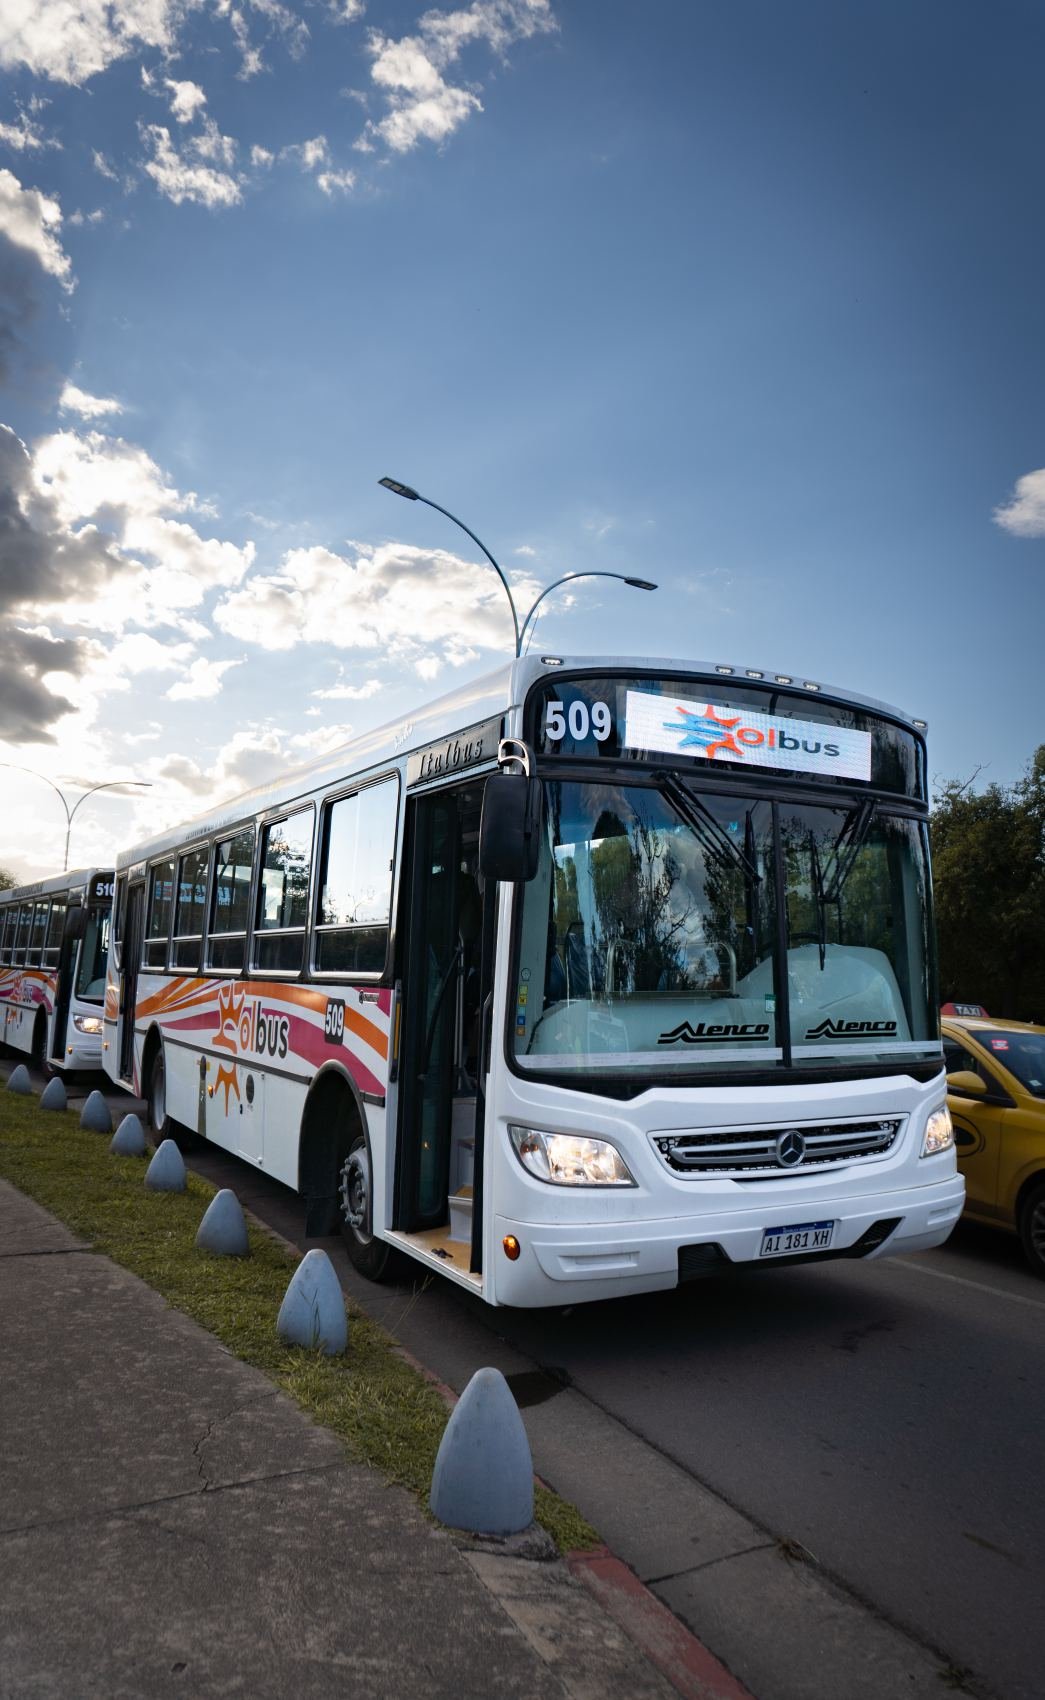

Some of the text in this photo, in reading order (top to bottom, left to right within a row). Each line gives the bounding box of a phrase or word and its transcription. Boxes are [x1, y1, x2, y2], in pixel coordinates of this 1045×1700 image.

[546, 701, 611, 741] 509
[418, 739, 483, 780] Italbus
[325, 1004, 344, 1037] 509
[955, 1006, 981, 1016] TAXI
[658, 1021, 769, 1044] Alenco
[805, 1018, 897, 1040] Alenco
[765, 1230, 829, 1252] AI 181 XH
